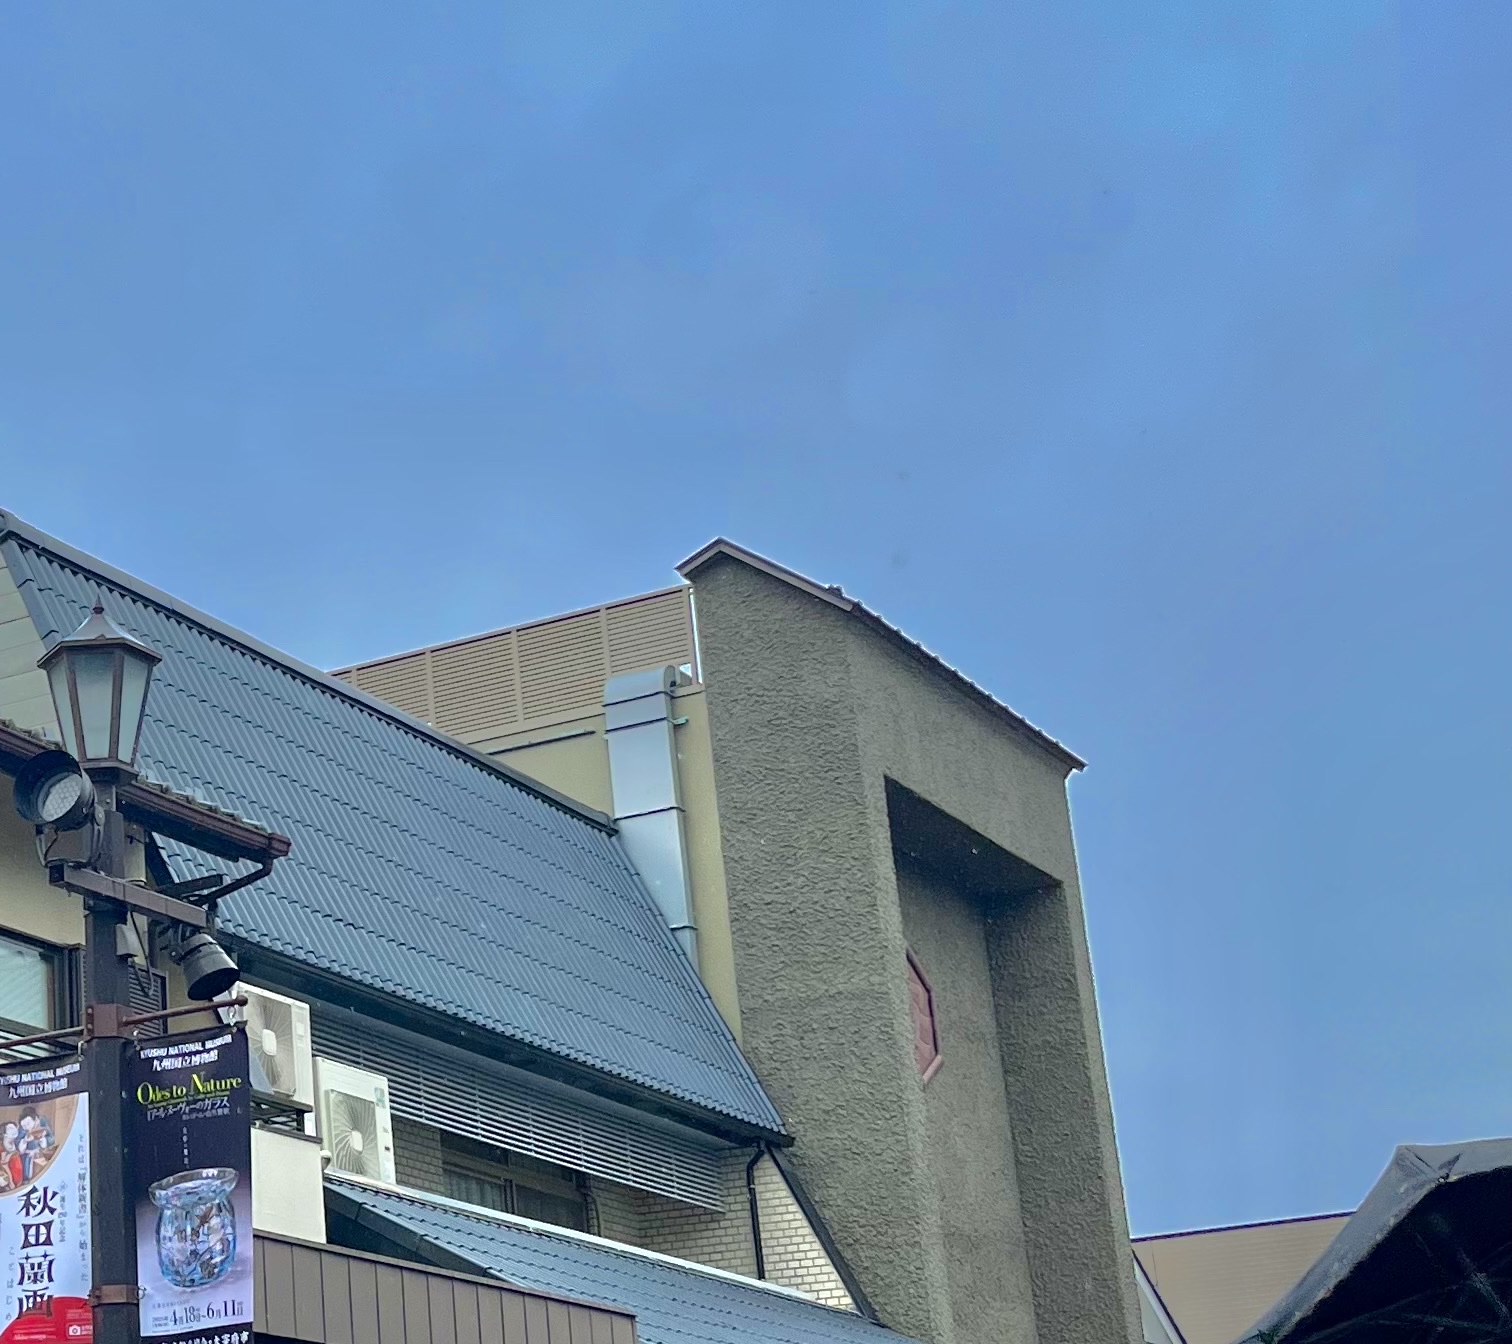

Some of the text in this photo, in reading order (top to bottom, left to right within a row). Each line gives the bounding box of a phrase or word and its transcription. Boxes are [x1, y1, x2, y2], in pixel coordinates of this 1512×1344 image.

[141, 1048, 168, 1059] KYUSHU
[168, 1042, 204, 1055] NATIONAL
[152, 1049, 219, 1072] 九州国立博物館
[21, 1069, 55, 1083] NATIONAL
[8, 1077, 68, 1099] 九州国立博物館
[137, 1082, 170, 1104] Odes
[172, 1085, 187, 1098] to
[188, 1071, 242, 1095] Nature
[16, 1184, 59, 1320] 秋田蘭画
